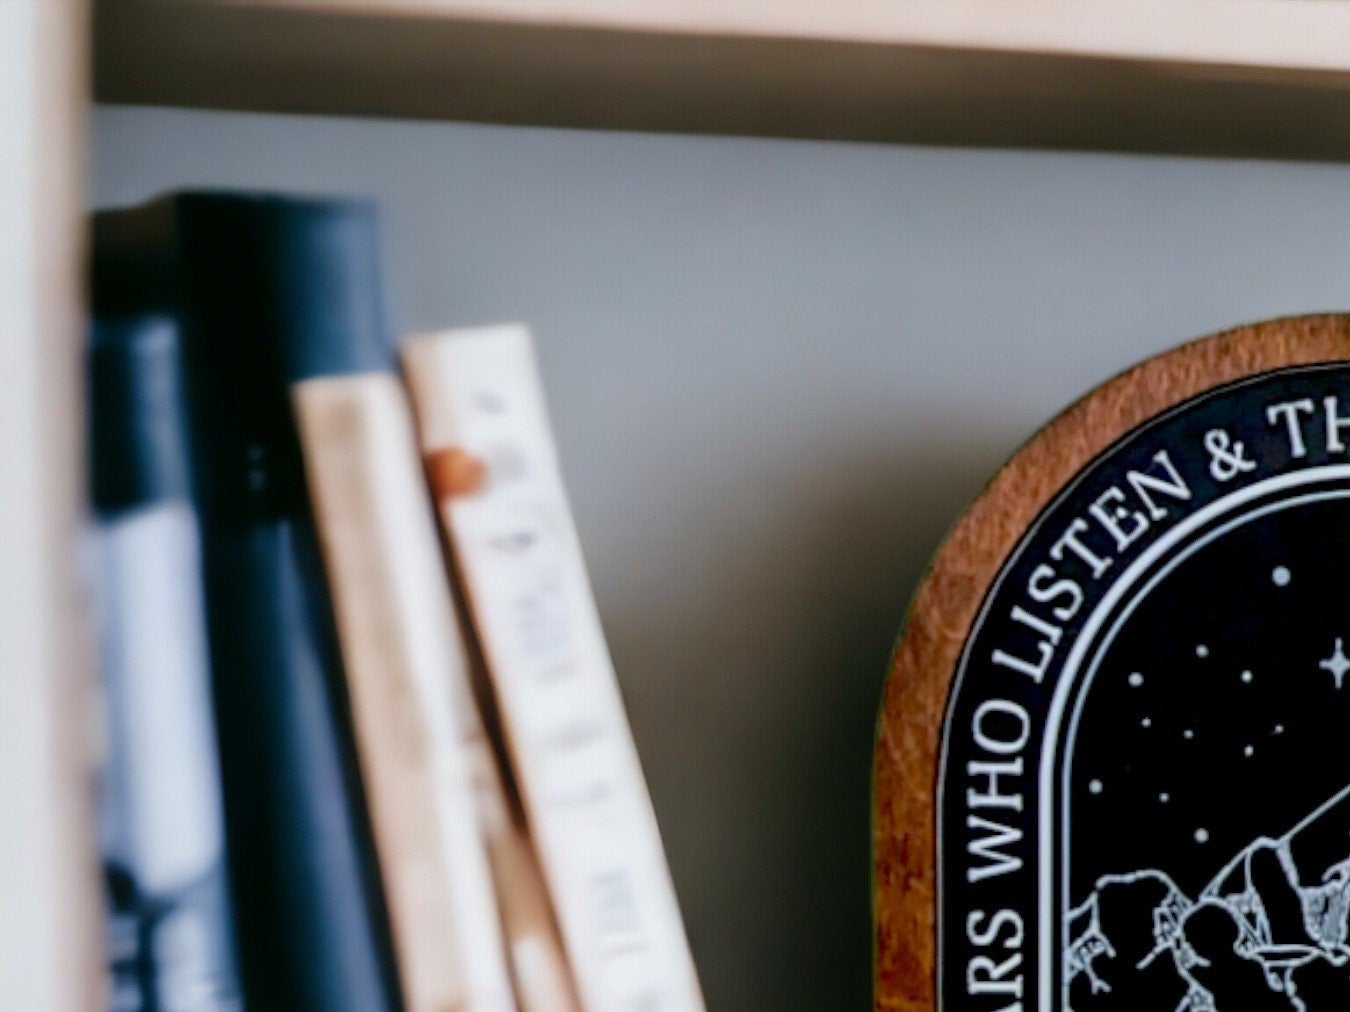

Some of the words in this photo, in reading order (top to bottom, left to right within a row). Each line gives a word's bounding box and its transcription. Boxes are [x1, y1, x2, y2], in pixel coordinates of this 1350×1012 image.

[1205, 428, 1256, 482] &
[991, 449, 1193, 684] LISTEN
[966, 698, 1031, 882] WHO
